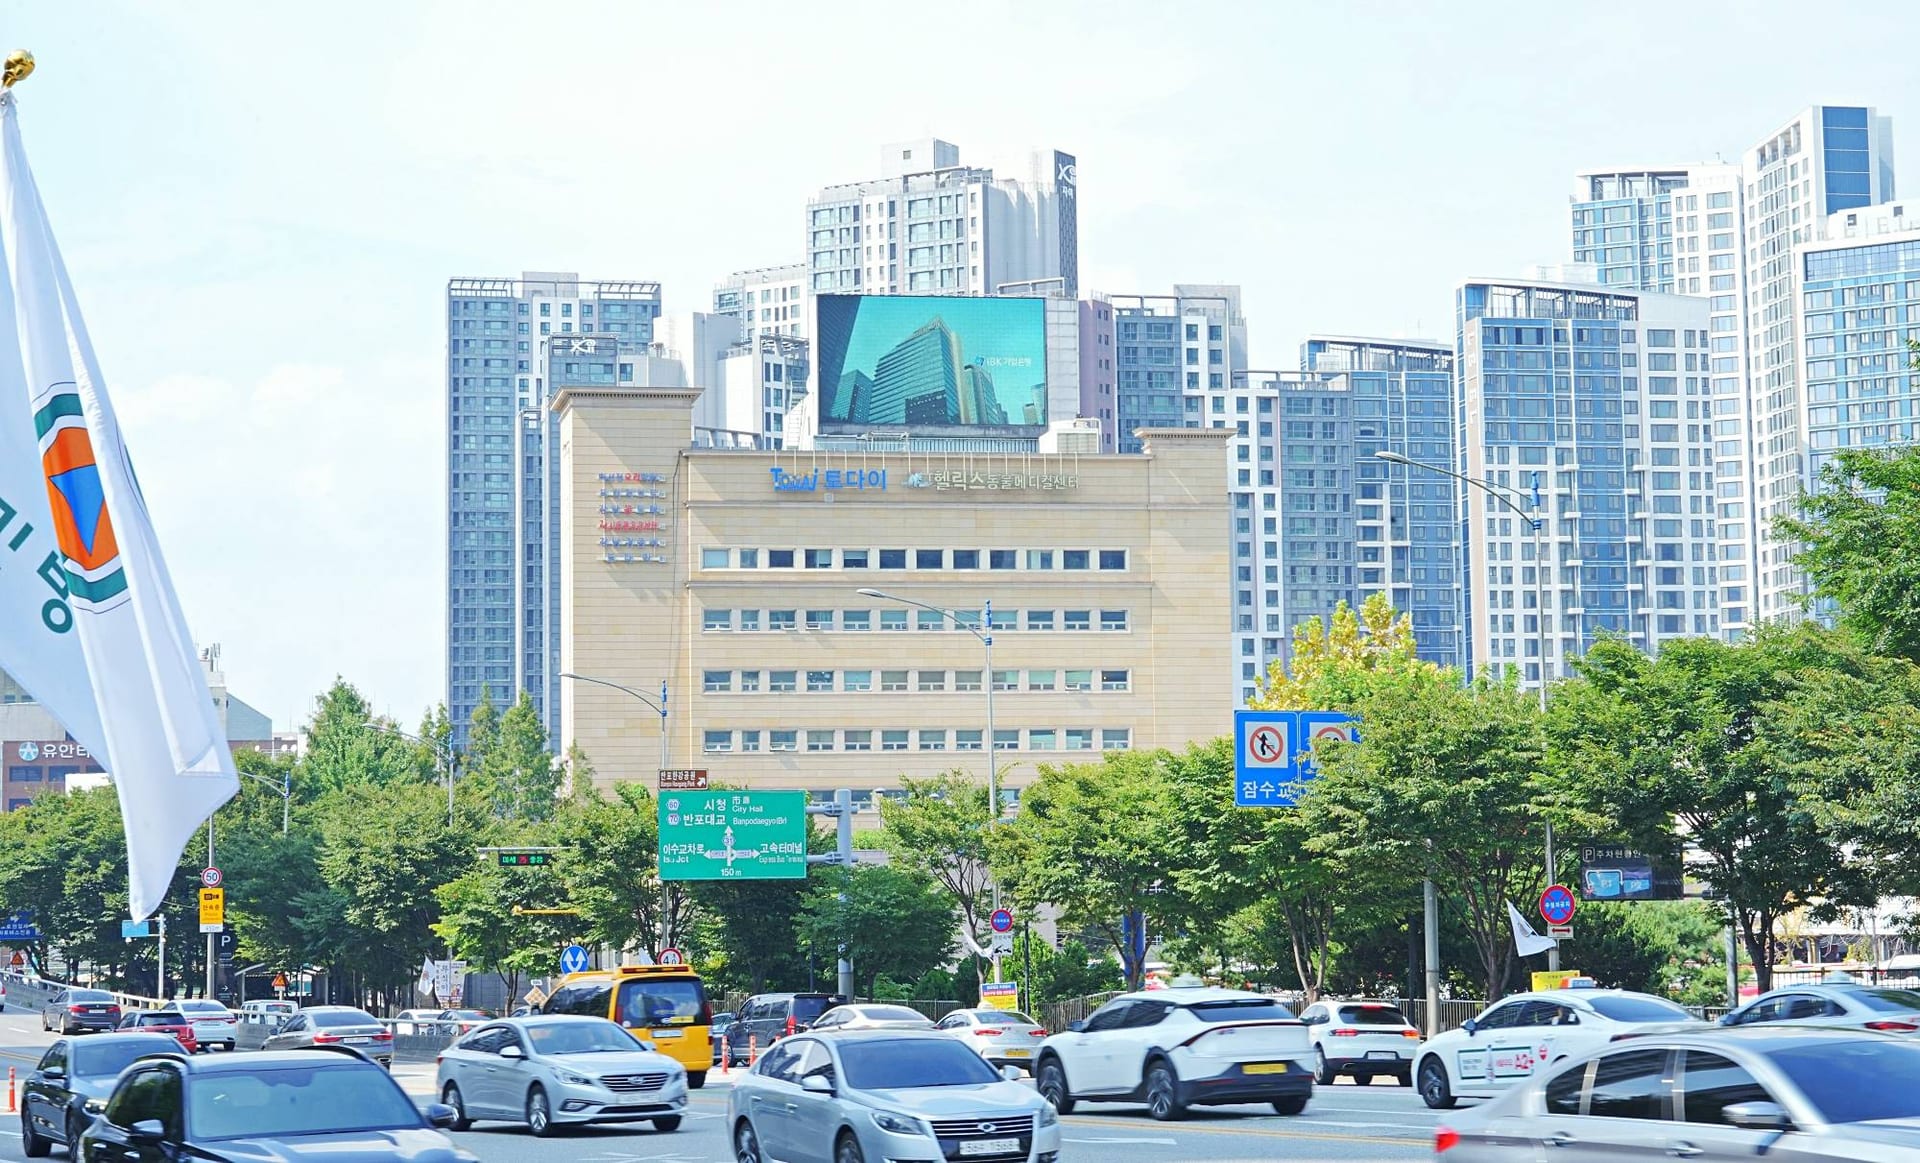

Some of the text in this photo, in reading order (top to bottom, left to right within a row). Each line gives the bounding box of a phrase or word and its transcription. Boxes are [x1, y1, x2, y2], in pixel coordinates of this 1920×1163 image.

[824, 468, 887, 491] 토다이
[704, 799, 727, 812] 시청
[732, 806, 747, 814] City
[683, 813, 726, 827] 반포대교
[663, 843, 705, 855] 이수교차로
[760, 843, 802, 855] 고속터미널
[206, 872, 218, 882] 50
[721, 868, 735, 877] 150
